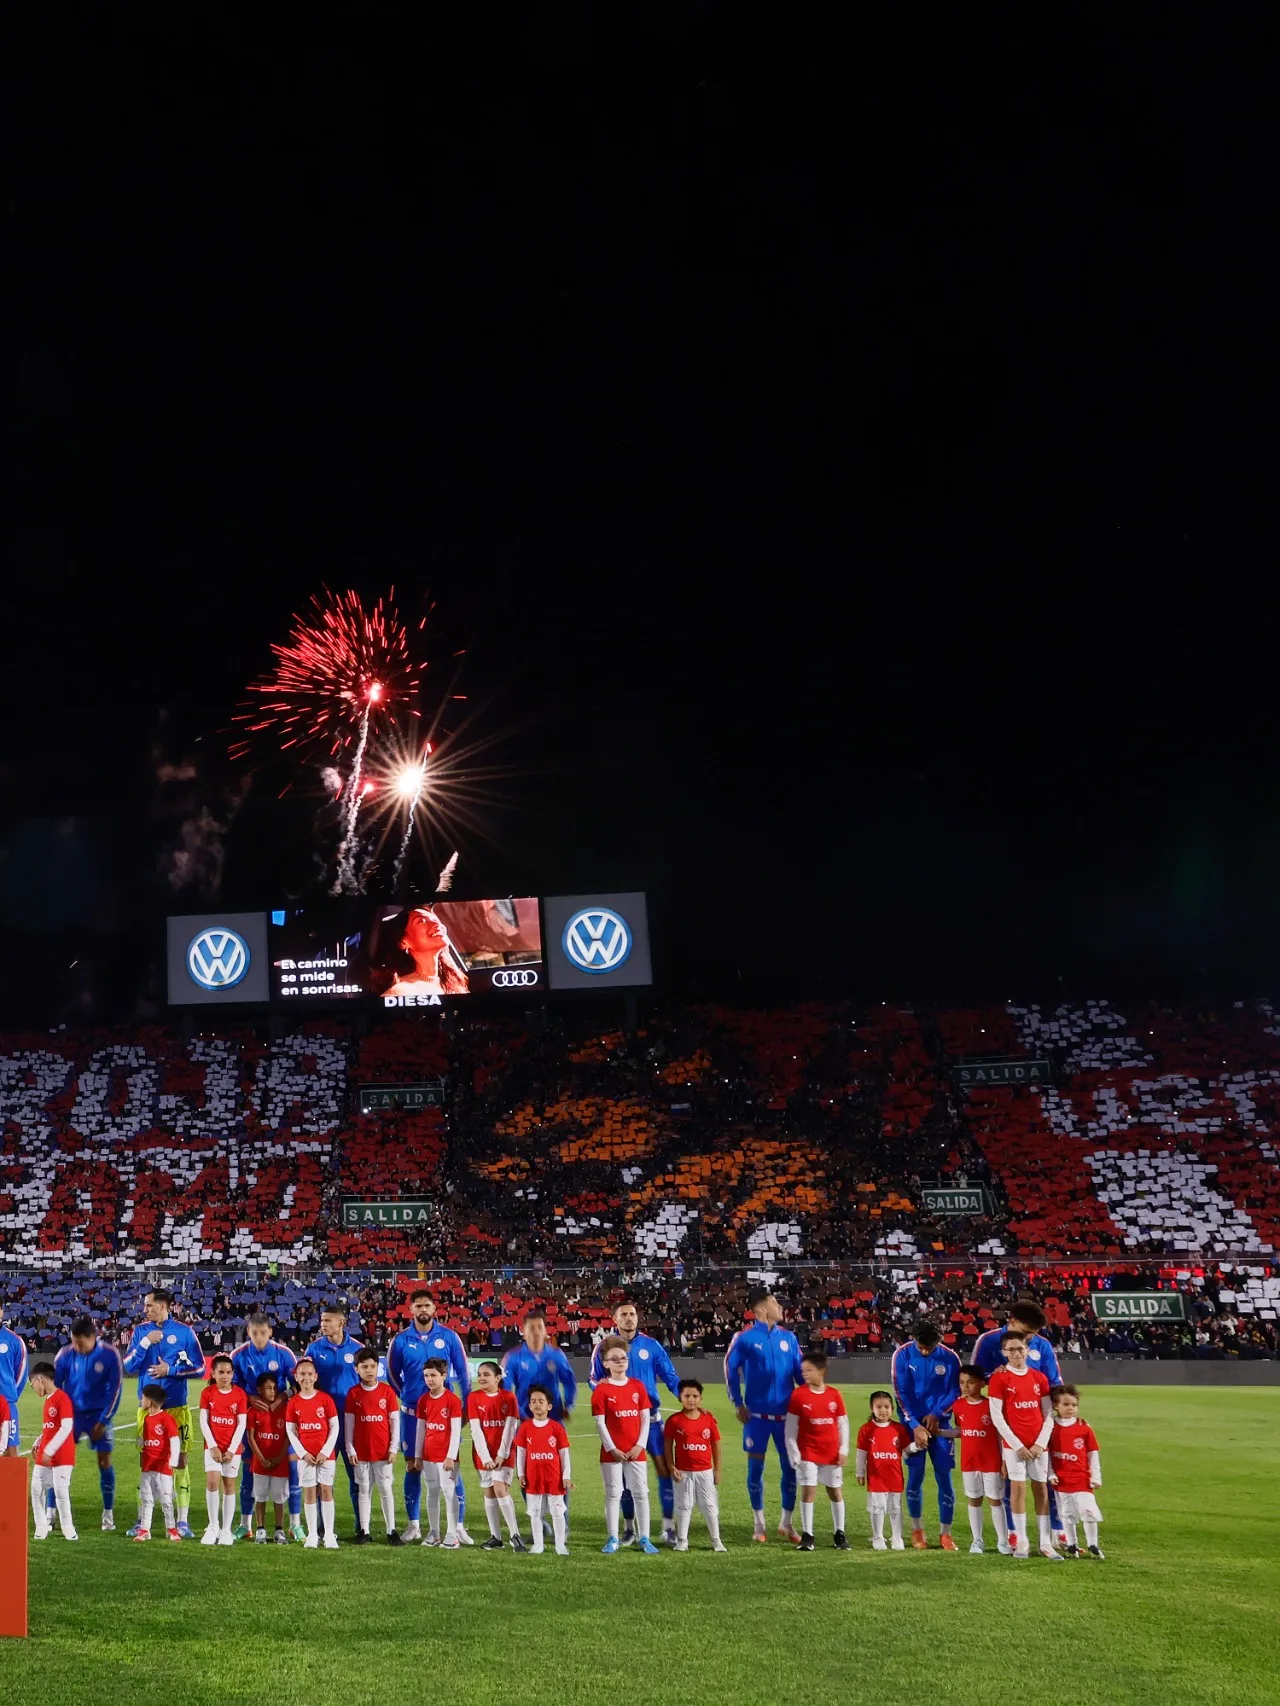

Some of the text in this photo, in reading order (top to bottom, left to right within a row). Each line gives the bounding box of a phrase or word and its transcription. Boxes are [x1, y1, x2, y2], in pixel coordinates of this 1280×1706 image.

[281, 958, 348, 970] El camino
[281, 971, 335, 982] se mide
[281, 984, 363, 996] en sonrisas.
[384, 995, 442, 1008] DIESA
[961, 1067, 1040, 1080] SALIDA
[927, 1196, 979, 1210] SALIDA
[349, 1209, 428, 1221] SALIDA
[1105, 1299, 1172, 1315] SALIDA
[1015, 1400, 1039, 1409] ueno
[361, 1414, 384, 1422] ueno
[615, 1409, 638, 1418] ueno
[212, 1416, 234, 1425] ueno
[483, 1420, 507, 1428] ueno
[810, 1417, 834, 1425] ueno
[300, 1422, 322, 1430] ueno
[179, 1425, 190, 1442] 12
[258, 1432, 280, 1440] ueno
[962, 1429, 987, 1438] ueno
[144, 1439, 161, 1447] eno
[683, 1442, 707, 1451] ueno
[530, 1452, 554, 1460] ueno
[873, 1452, 898, 1460] ueno
